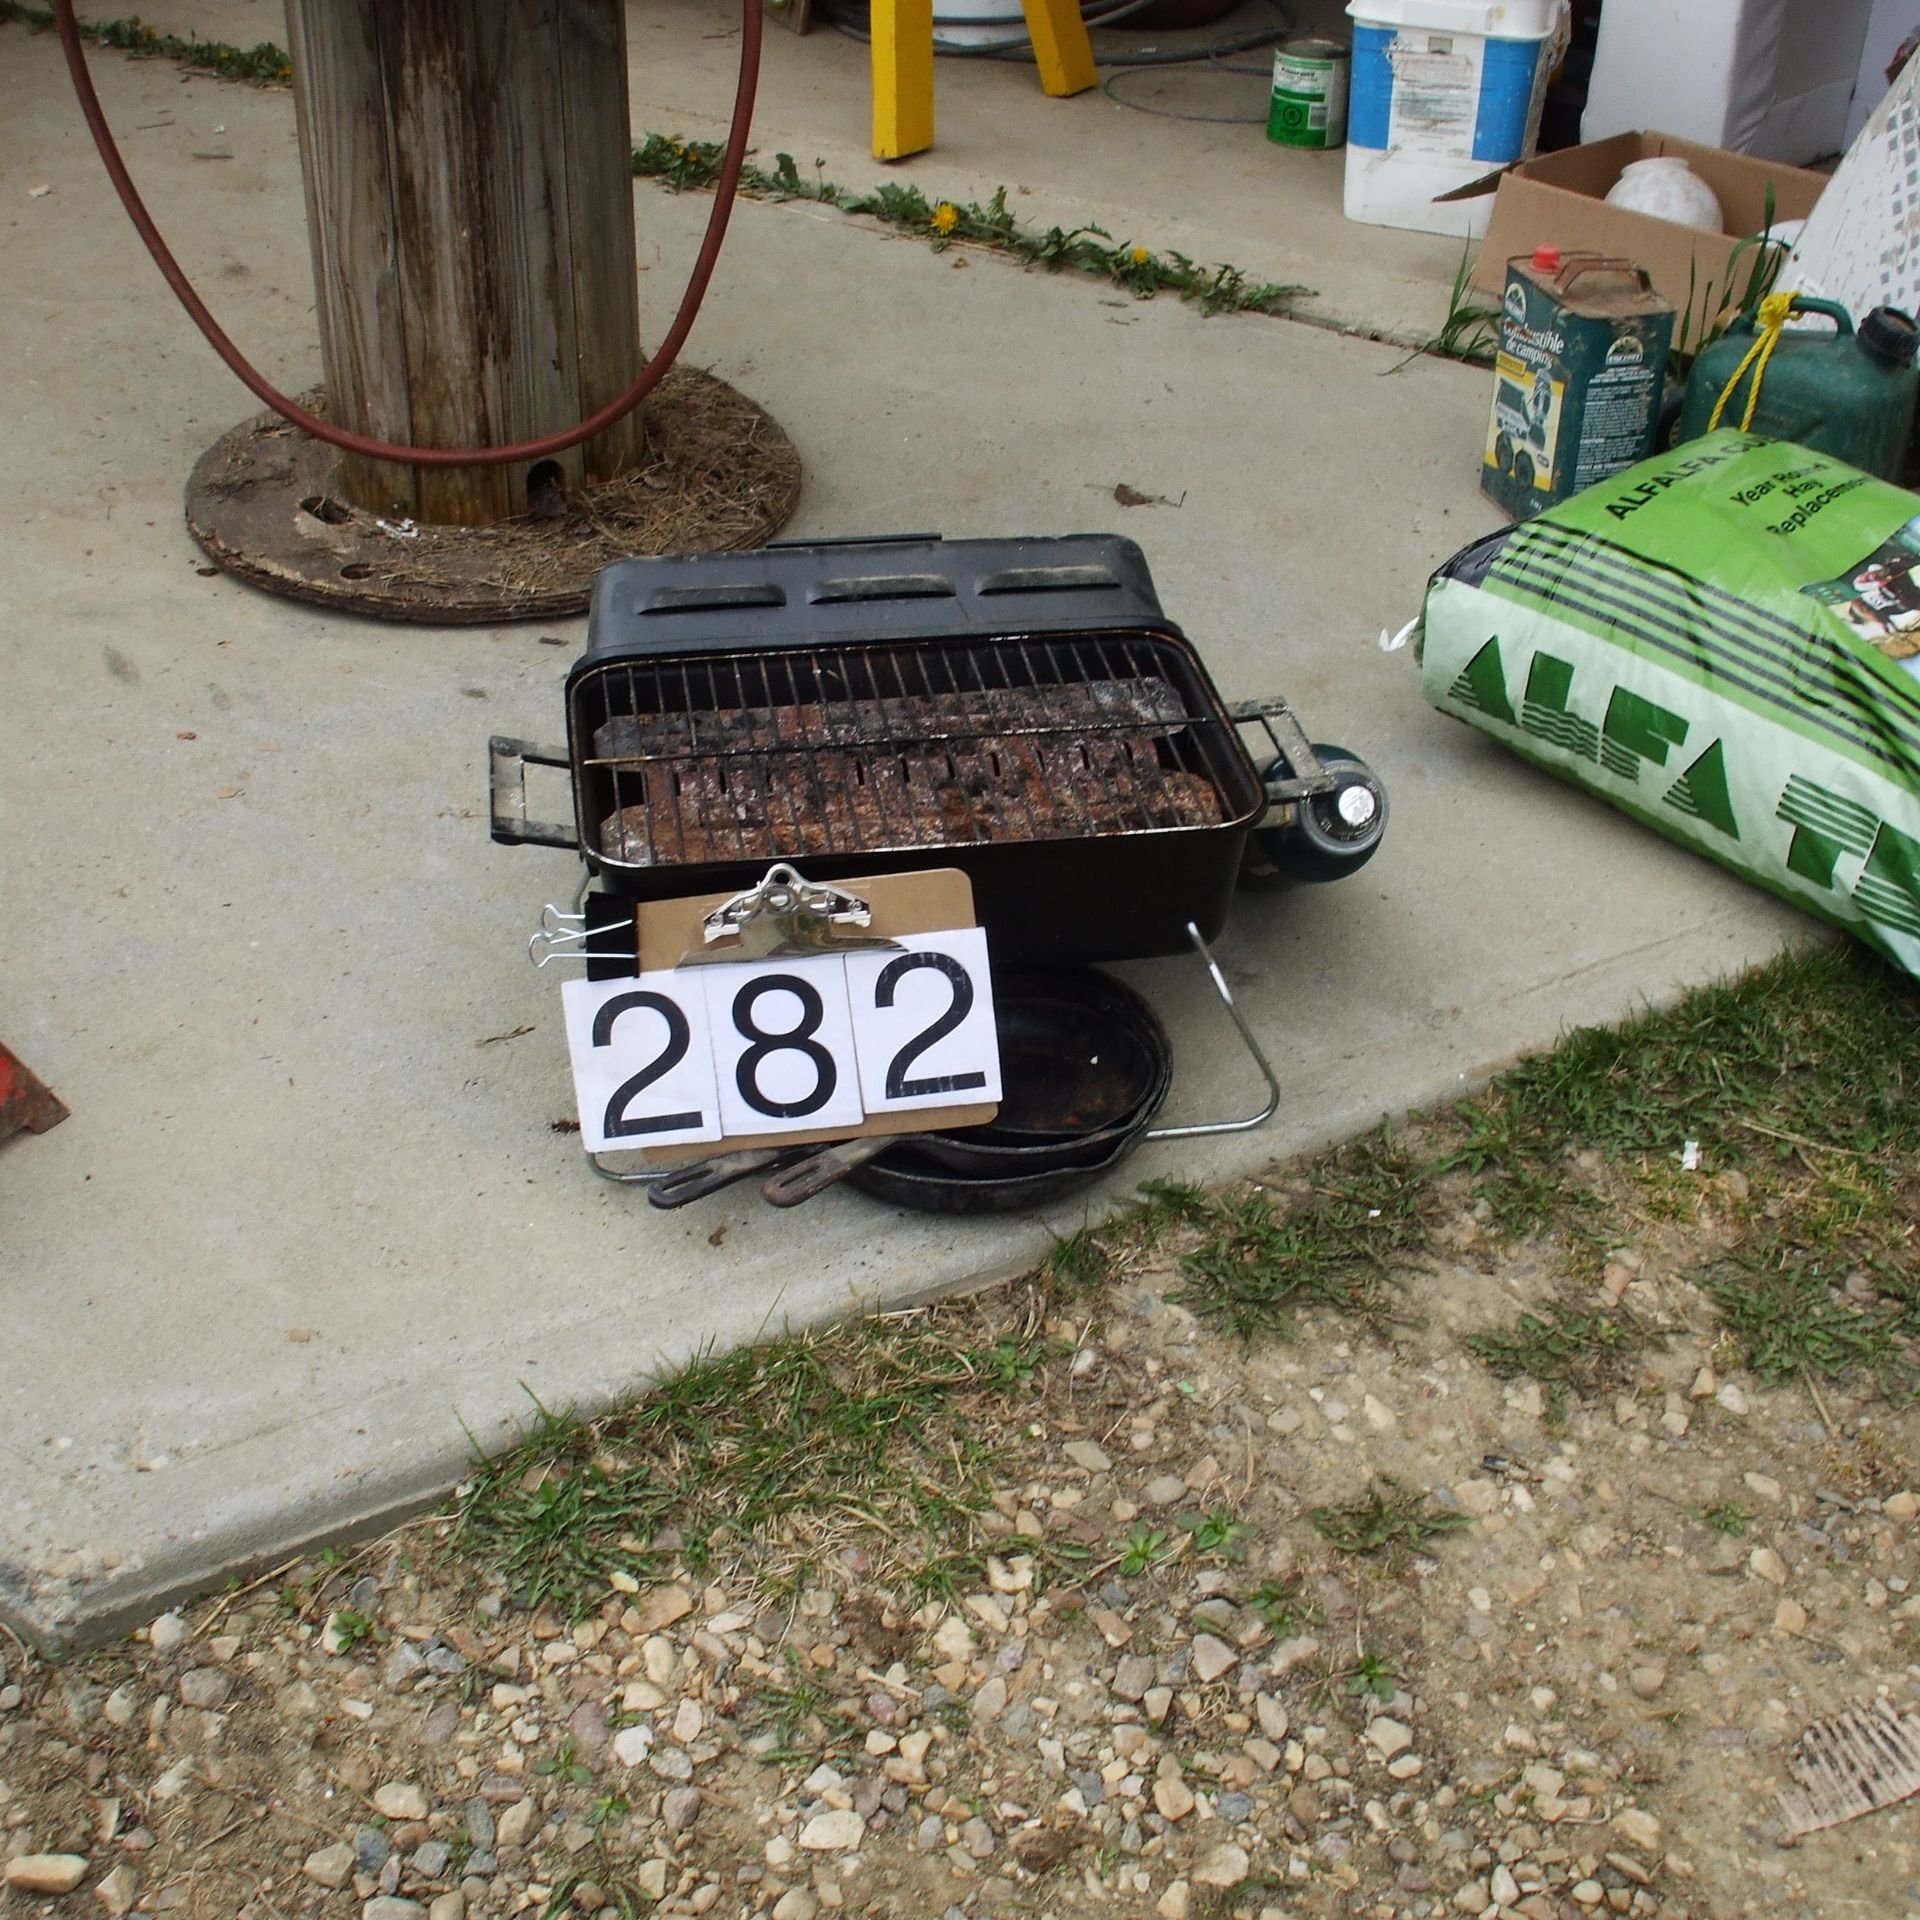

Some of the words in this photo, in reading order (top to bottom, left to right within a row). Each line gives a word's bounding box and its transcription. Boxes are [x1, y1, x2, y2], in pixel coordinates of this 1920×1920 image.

[1506, 335, 1517, 353] de
[1516, 342, 1554, 371] camping
[1604, 456, 1728, 521] ALFALFA
[1729, 480, 1776, 508] Year
[1781, 477, 1824, 500] Hay
[592, 950, 987, 1139] 282
